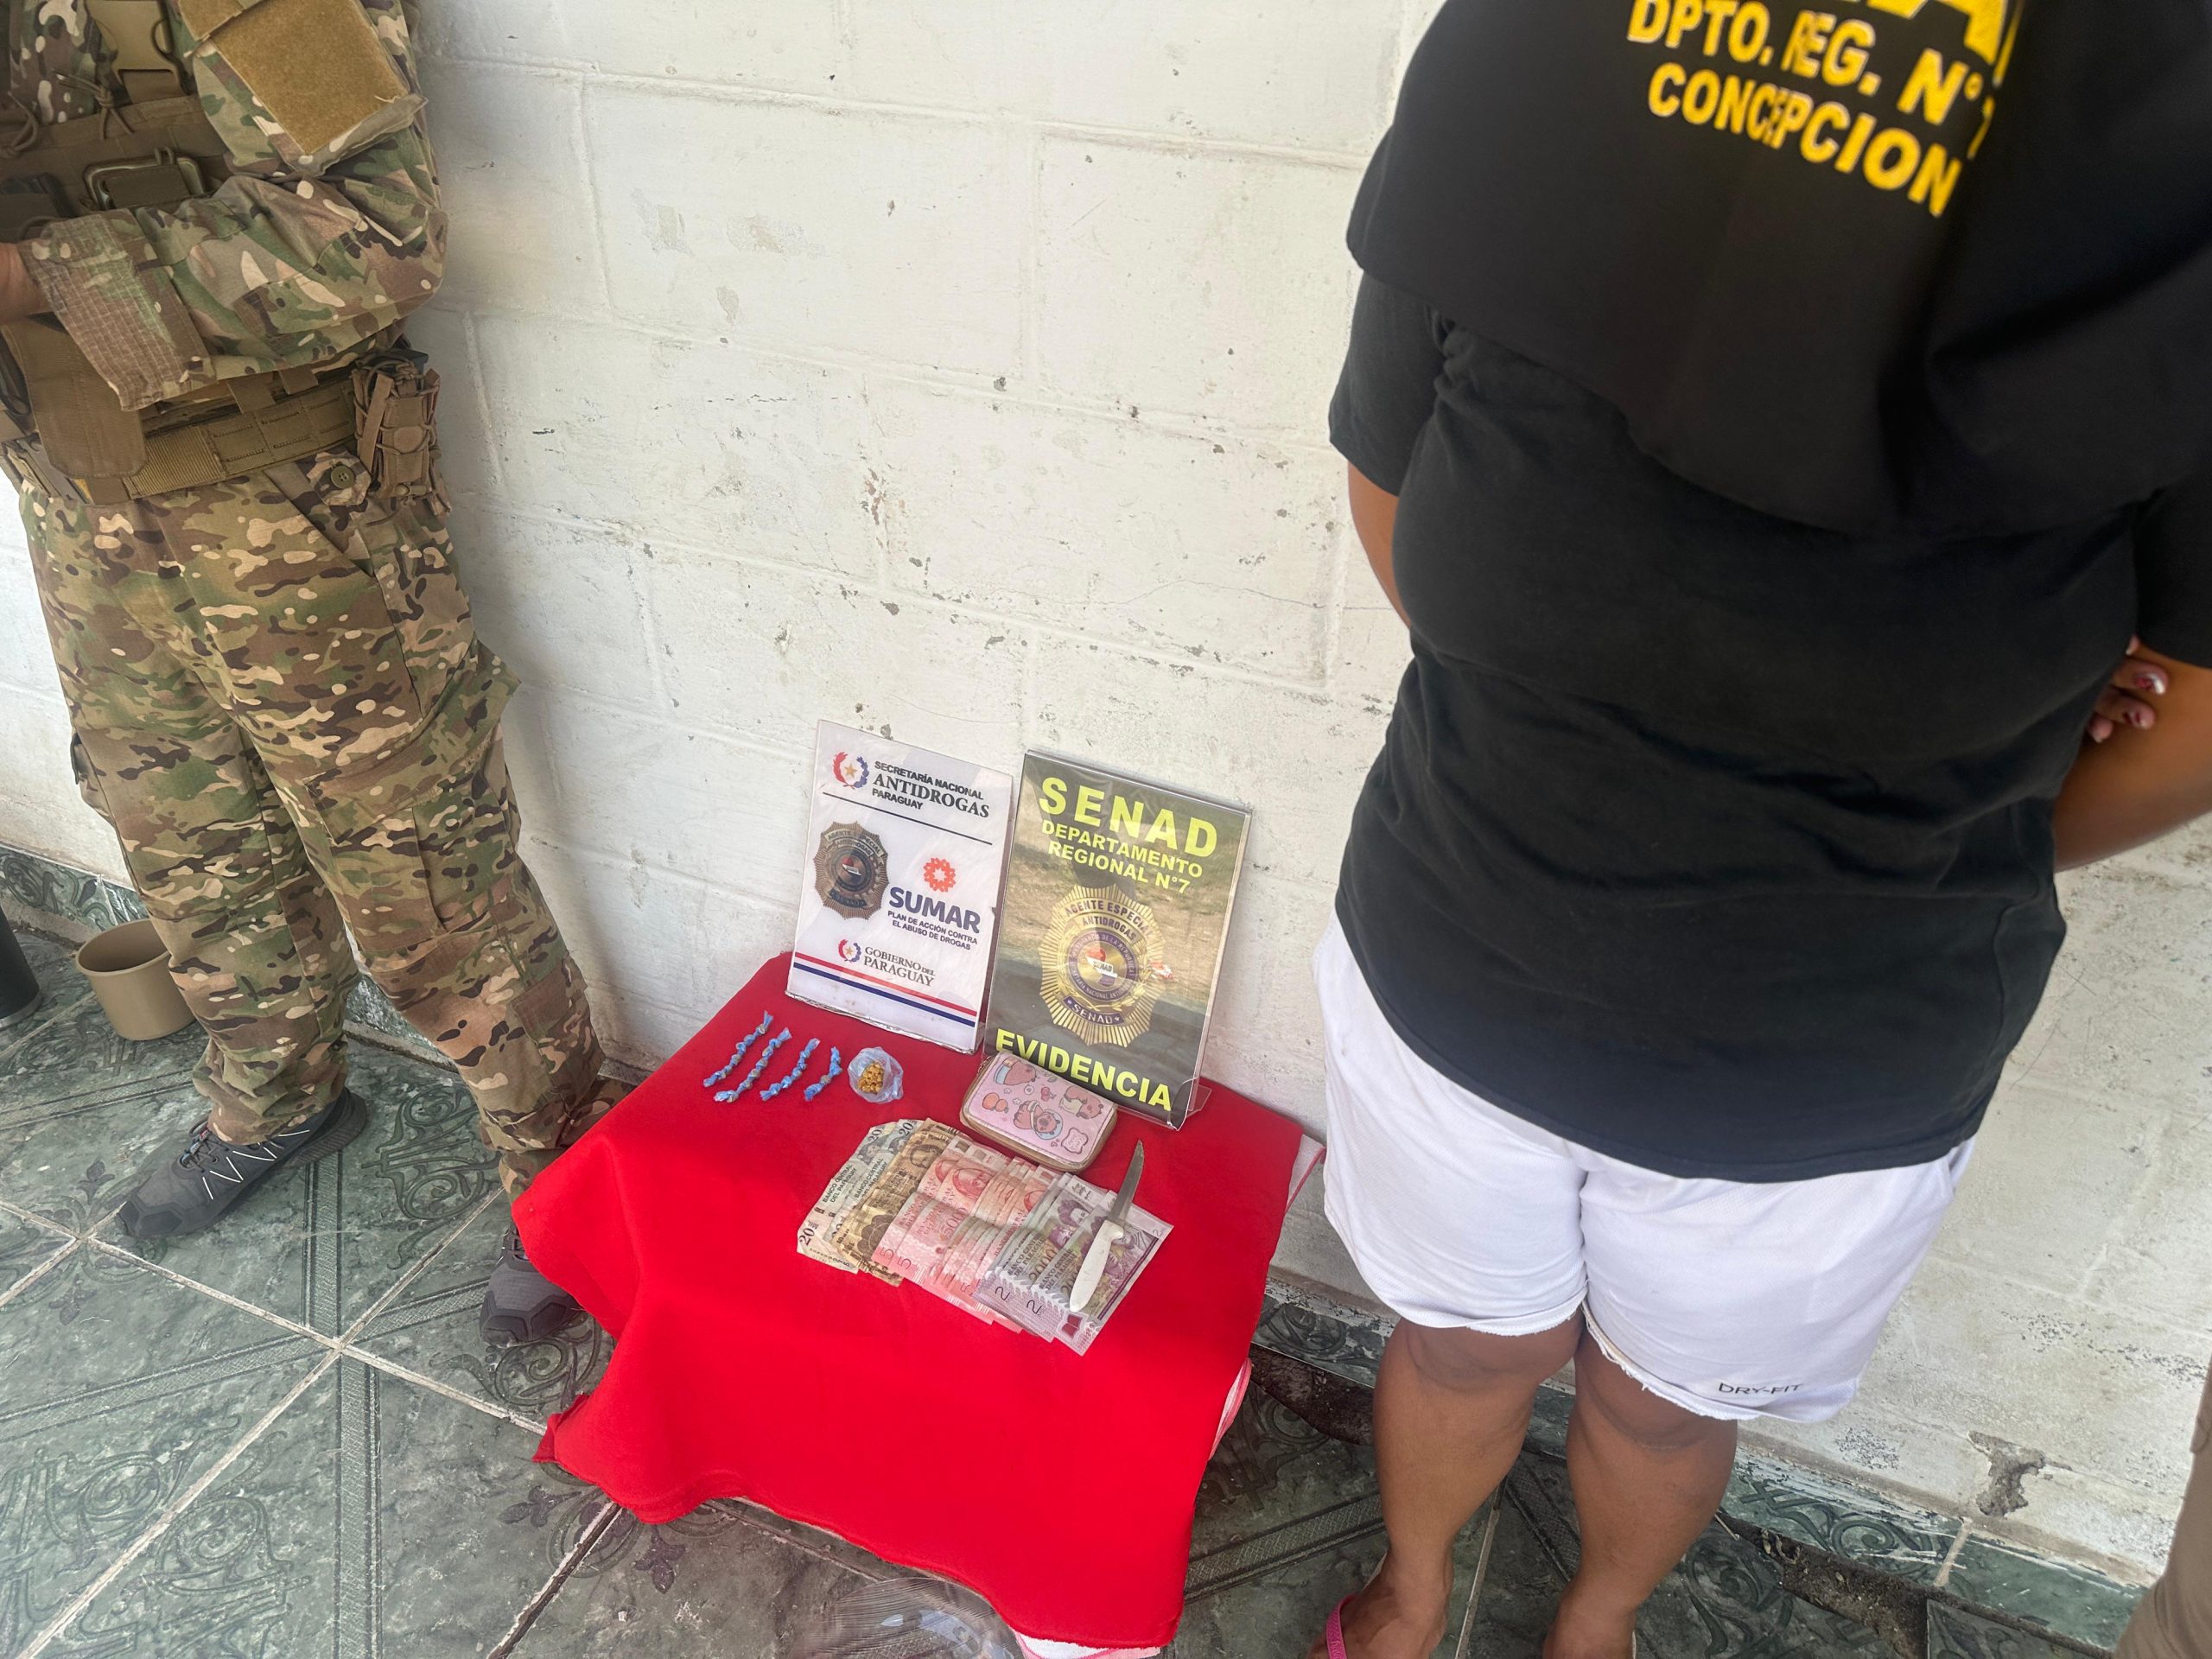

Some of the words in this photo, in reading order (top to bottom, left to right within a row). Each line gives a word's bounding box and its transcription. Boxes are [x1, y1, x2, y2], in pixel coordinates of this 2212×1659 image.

[1627, 0, 1774, 66] DPTO.
[874, 760, 934, 785] SECRETARÍA
[935, 779, 984, 800] NACIONAL
[872, 788, 924, 810] PARAGUAY
[873, 773, 989, 817] ANTIDROGAS
[1039, 777, 1217, 858] SENAD
[1041, 819, 1204, 878] DEPARTAMENTO
[1048, 840, 1149, 883] REGIONAL
[889, 887, 981, 933] SUMAR
[1065, 899, 1104, 918] AGENTE
[887, 910, 906, 922] PLAN
[907, 916, 918, 925] DE
[918, 920, 947, 935] ACCIÓN
[947, 930, 978, 944] CONTRA
[892, 919, 901, 928] EL
[902, 922, 928, 937] ABUSO
[939, 935, 971, 950] DROGAS
[1082, 915, 1137, 941] ANTIDROGAS
[864, 955, 934, 987] PARAGUAY
[865, 946, 922, 971] GOBIERNO
[921, 966, 936, 976] DEL
[1071, 1004, 1114, 1025] SENAD
[995, 1028, 1172, 1111] EVIDENCIA
[868, 1128, 882, 1141] 20
[899, 1122, 914, 1136] 20
[855, 1179, 868, 1198] BANCO
[868, 1158, 884, 1181] CENTRAL
[822, 1182, 837, 1204] BANCO
[830, 1192, 838, 1204] DEL
[798, 1227, 816, 1246] 20
[880, 1246, 895, 1260] 5
[898, 1255, 912, 1270] 5
[1007, 1254, 1024, 1275] BANCO
[1039, 1268, 1056, 1290] BANCO
[995, 1286, 1011, 1301] 2
[1027, 1300, 1043, 1314] 2
[1718, 1382, 1804, 1395] DRY-FIT
